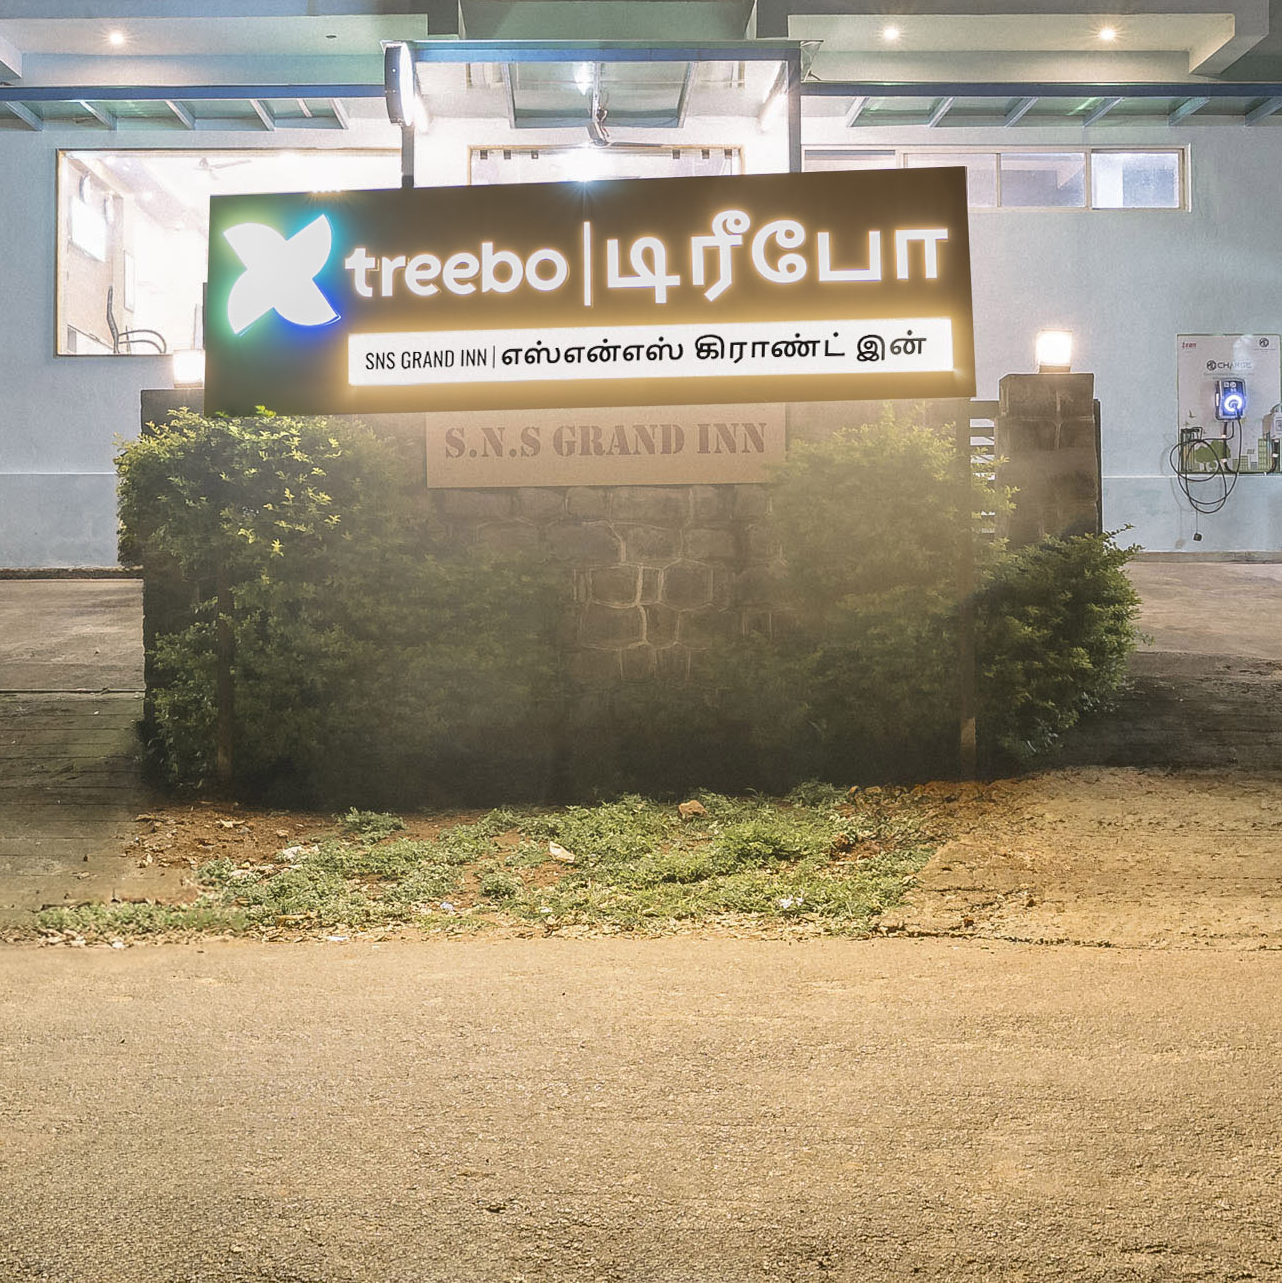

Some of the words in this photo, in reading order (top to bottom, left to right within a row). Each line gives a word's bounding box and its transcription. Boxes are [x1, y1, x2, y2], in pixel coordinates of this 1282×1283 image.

[345, 241, 569, 298] treebo
[606, 209, 949, 304] டிரீபோ
[365, 351, 396, 370] SNS
[401, 349, 455, 369] GRAND
[460, 347, 487, 367] INN
[501, 336, 684, 365] எஸ்என்எஸ்
[694, 331, 846, 364] கிராண்ட்
[856, 329, 927, 362] இன்
[1217, 361, 1254, 370] CHARGE
[444, 425, 541, 458] S.N.S
[552, 423, 686, 457] GRAND
[696, 422, 767, 455] INN
